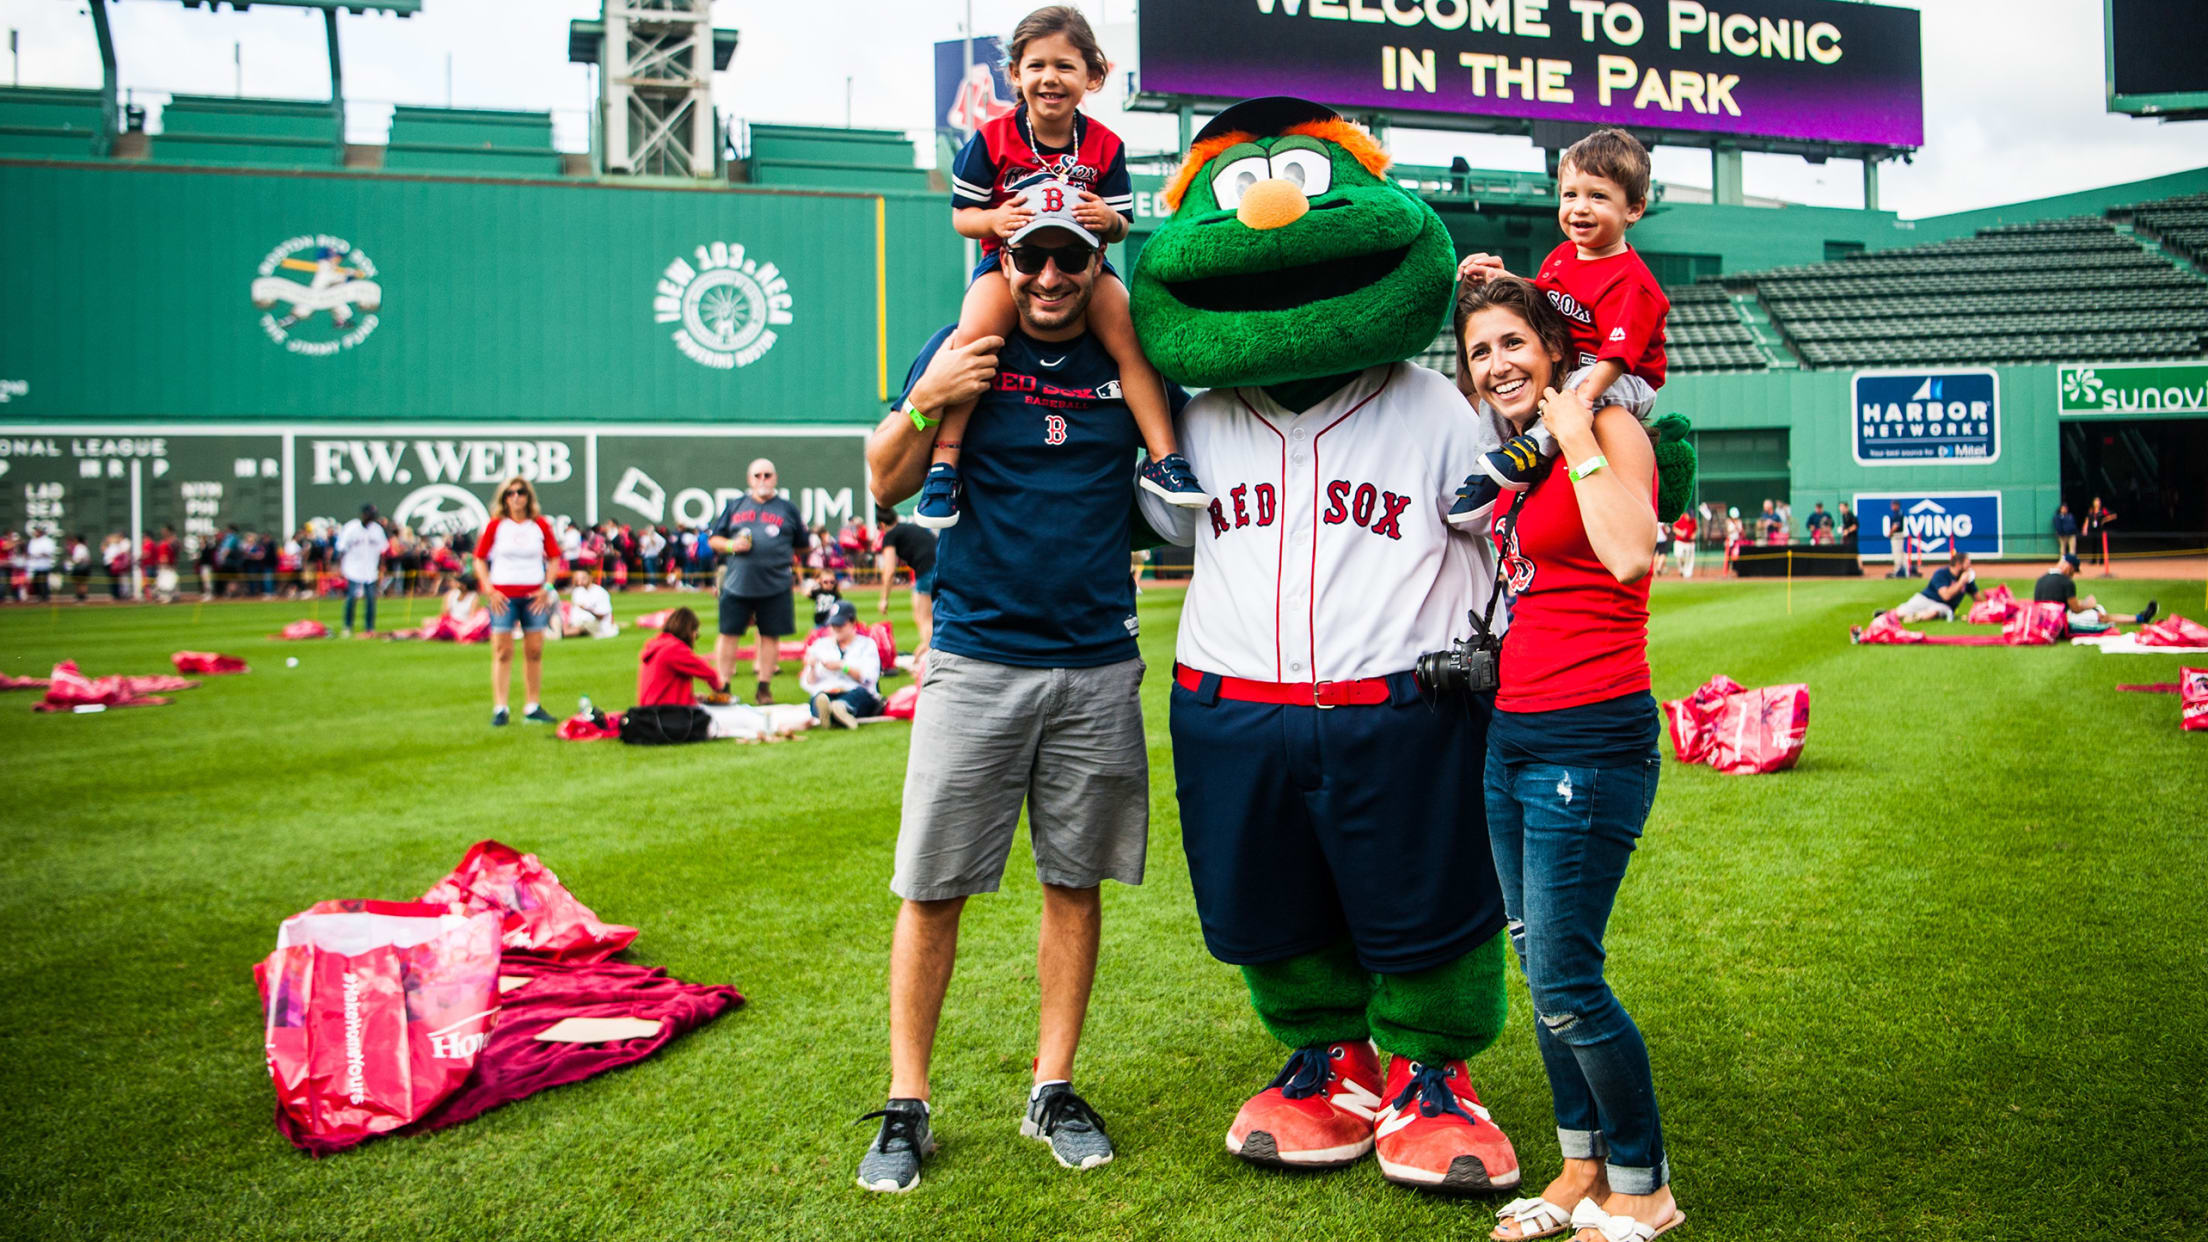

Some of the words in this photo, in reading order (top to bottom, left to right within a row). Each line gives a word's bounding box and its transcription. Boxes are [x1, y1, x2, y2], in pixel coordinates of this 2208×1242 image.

[1570, 0, 1644, 46] TO
[1382, 46, 1436, 93] IN
[1459, 52, 1574, 103] THE
[1041, 186, 1064, 212] B
[694, 241, 745, 271] 103
[1024, 395, 1089, 410] BASEBALL
[1044, 414, 1067, 446] B
[1863, 422, 1989, 438] NETWORKS
[71, 438, 167, 456] LEAGUE
[107, 459, 124, 478] R
[152, 459, 169, 478] P
[261, 458, 279, 478] R
[414, 440, 573, 484] WEBB
[1207, 482, 1277, 540] RED
[1323, 480, 1412, 541] SOX
